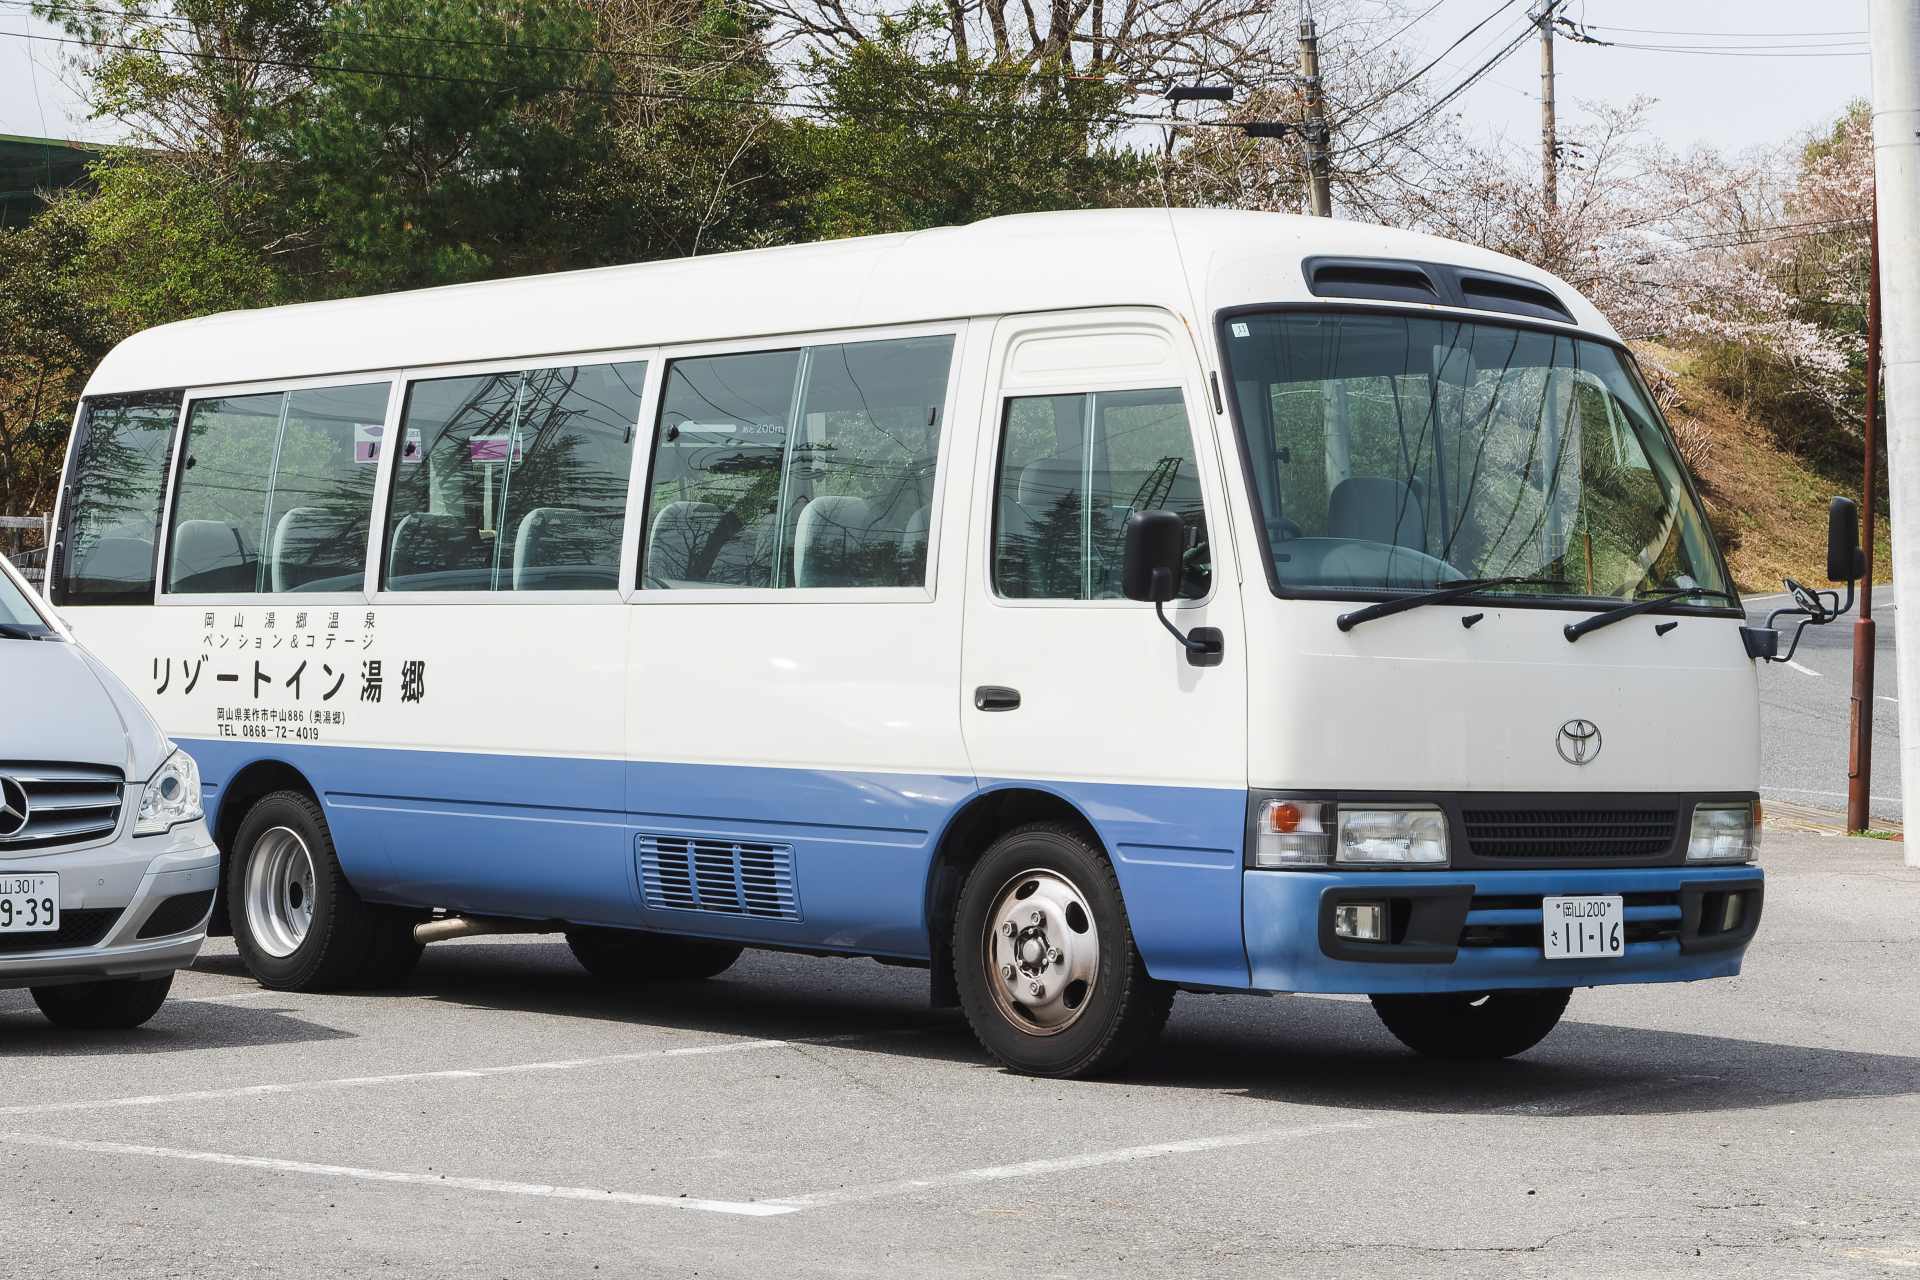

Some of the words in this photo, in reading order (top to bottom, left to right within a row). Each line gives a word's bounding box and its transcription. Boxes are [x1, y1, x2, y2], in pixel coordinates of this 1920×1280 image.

[153, 654, 426, 704] リゾートイン湯郷
[218, 724, 237, 737] TEL
[243, 725, 319, 740] 0868-72-4019
[1565, 922, 1620, 953] 11-16
